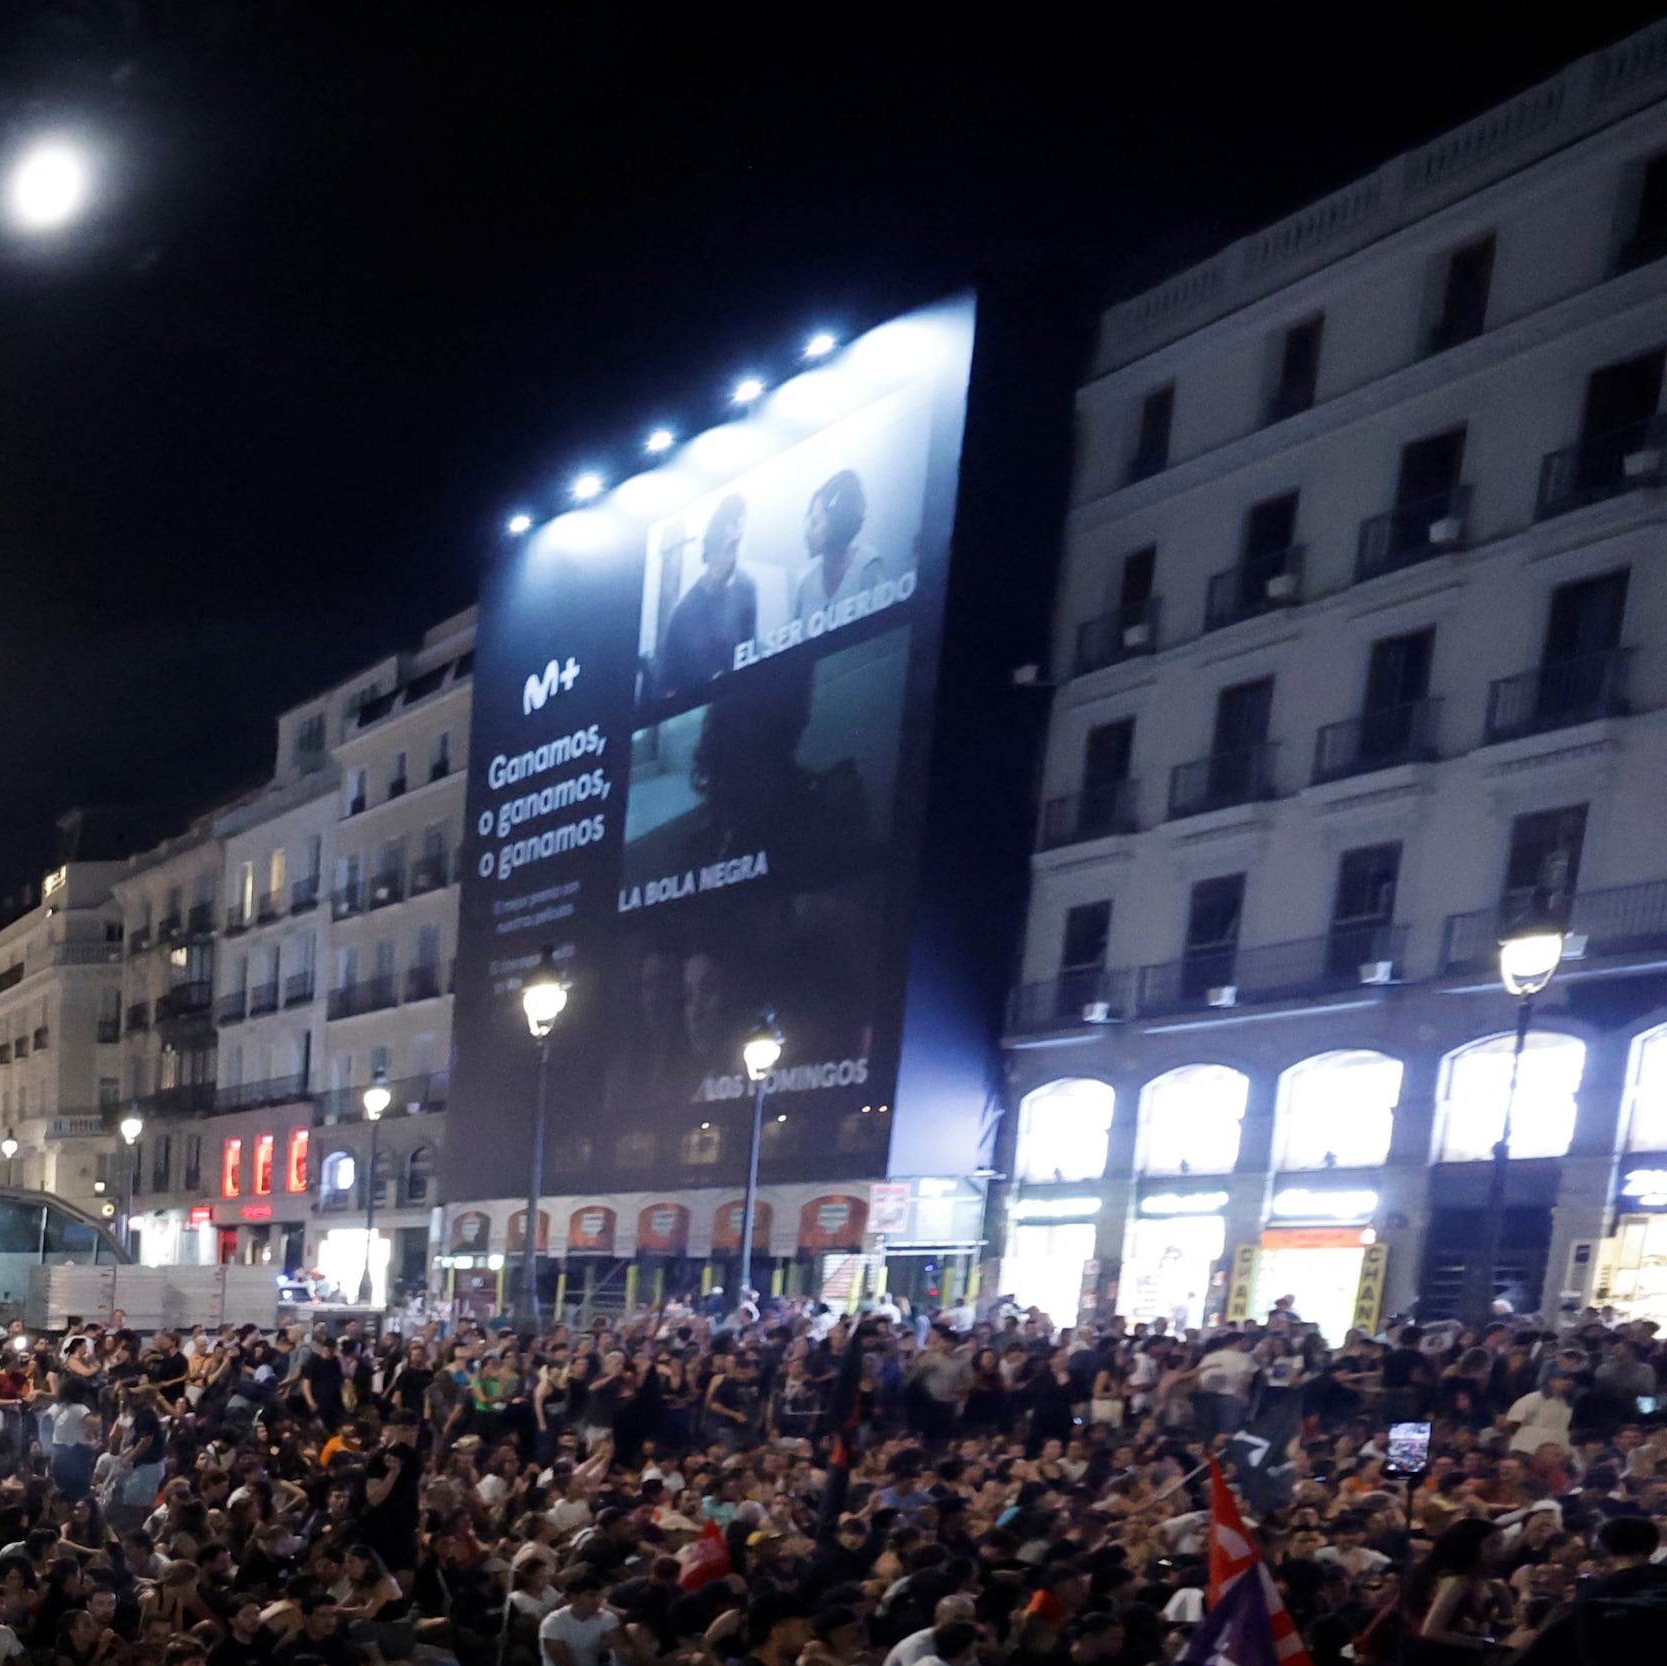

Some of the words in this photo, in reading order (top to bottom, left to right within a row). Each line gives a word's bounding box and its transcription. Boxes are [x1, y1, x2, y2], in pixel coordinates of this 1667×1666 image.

[807, 571, 918, 638] QUERIDO
[488, 724, 608, 791] Ganamos,
[478, 810, 495, 836] o
[496, 768, 612, 838] ganamos,
[478, 852, 495, 878] o
[497, 814, 605, 880] ganamos
[618, 886, 643, 913] LA
[644, 871, 696, 907] BOLA
[699, 850, 769, 893] NEGRA
